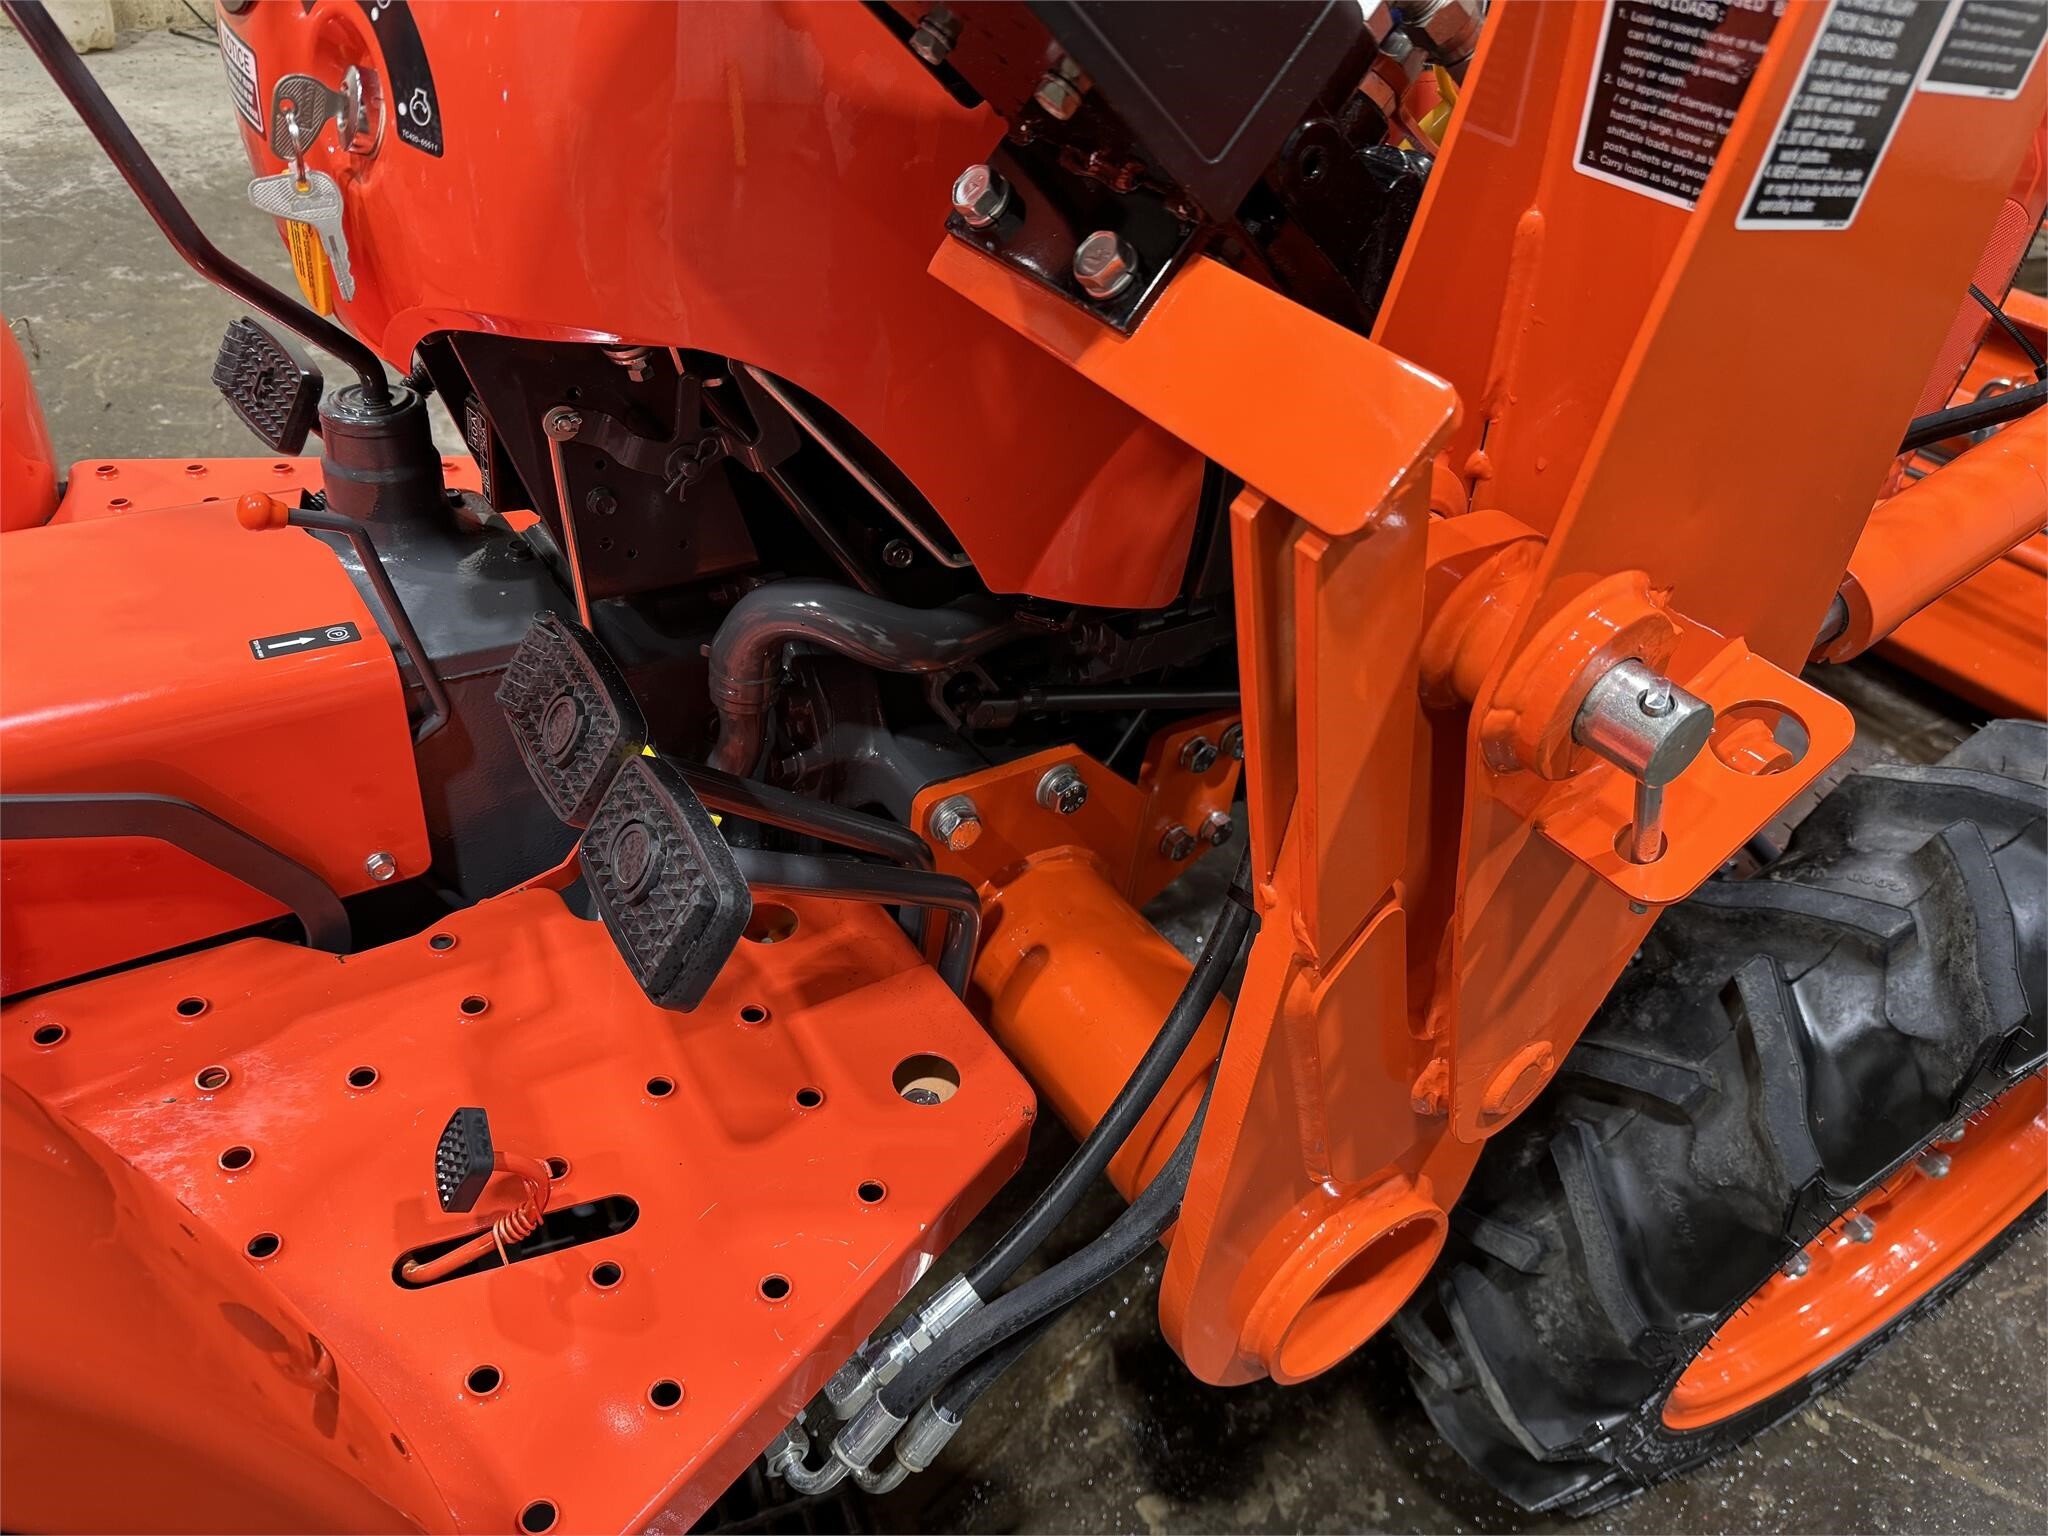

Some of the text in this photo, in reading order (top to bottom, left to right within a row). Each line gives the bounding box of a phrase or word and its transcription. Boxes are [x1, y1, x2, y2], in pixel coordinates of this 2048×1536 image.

[1626, 28, 1645, 41] can
[1645, 32, 1661, 46] fall
[1661, 38, 1673, 49] or
[1673, 40, 1690, 53] roll
[1690, 44, 1714, 60] back
[1630, 10, 1654, 25] Load
[1655, 19, 1668, 29] on
[1669, 20, 1699, 37] raised
[1699, 28, 1735, 47] bucket
[1619, 61, 1687, 88] injury or death.
[1622, 44, 1739, 85] operator causing serious
[1602, 74, 1736, 119] 2. Use approved clamping an
[1618, 96, 1629, 106] or
[1629, 98, 1656, 116] guard
[1656, 106, 1715, 132] attachments
[1606, 124, 1644, 144] shiftable
[1644, 136, 1670, 152] loads
[1670, 144, 1694, 159] such
[1694, 153, 1707, 163] as
[1608, 108, 1648, 130] handling
[1675, 128, 1701, 145] loose
[1702, 138, 1714, 148] or
[1586, 150, 1596, 160] 3.
[1599, 153, 1623, 172] Carry
[1623, 162, 1648, 178] loads
[1648, 172, 1661, 182] as
[1661, 174, 1679, 188] low
[1679, 181, 1692, 192] as
[1602, 139, 1629, 158] posts,
[1630, 148, 1661, 166] sheets
[1661, 159, 1672, 170] or
